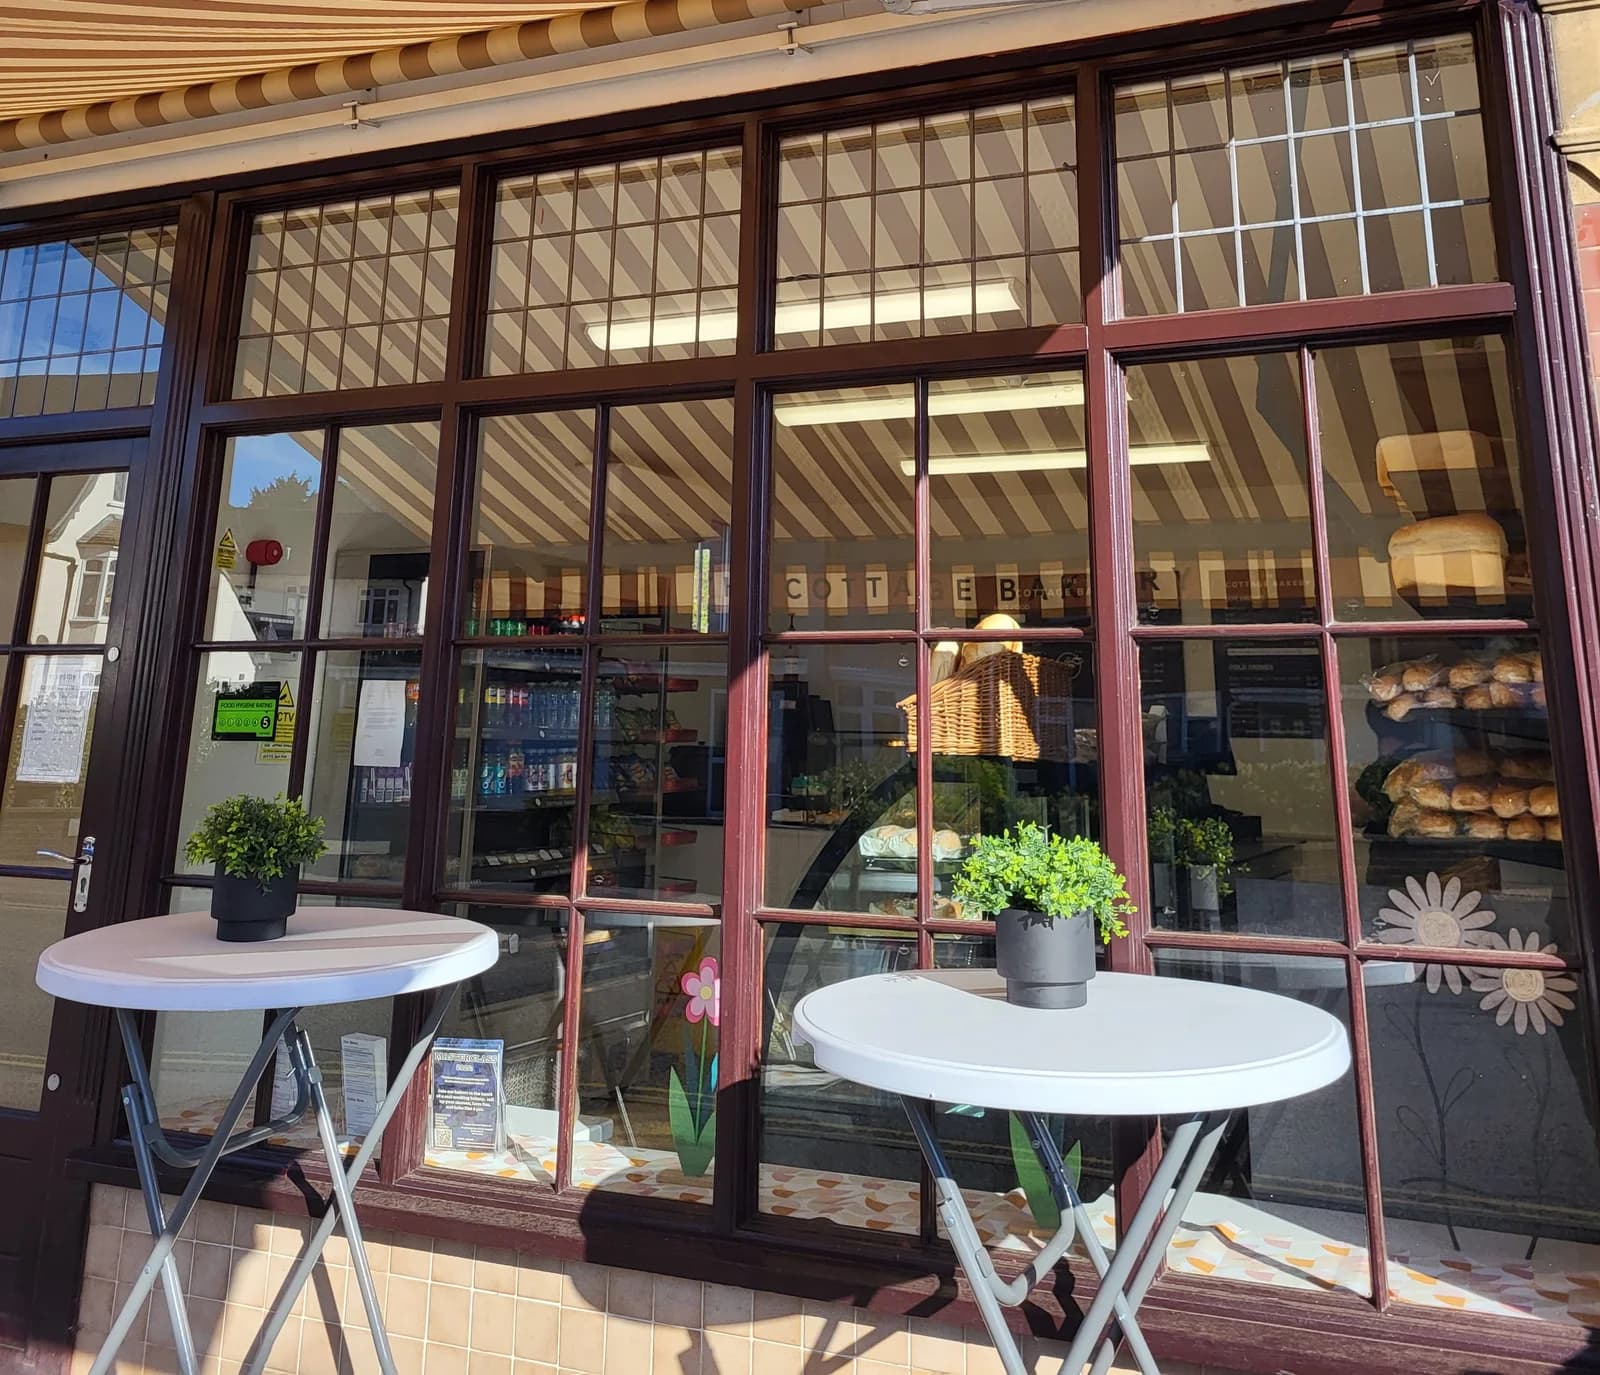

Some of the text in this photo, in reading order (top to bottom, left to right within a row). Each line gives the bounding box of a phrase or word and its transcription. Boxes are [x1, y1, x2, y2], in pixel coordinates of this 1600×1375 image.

[786, 567, 1190, 602] COTTAGE BAKRY
[278, 711, 295, 722] CTV
[434, 1052, 497, 1063] MASTERCLASS
